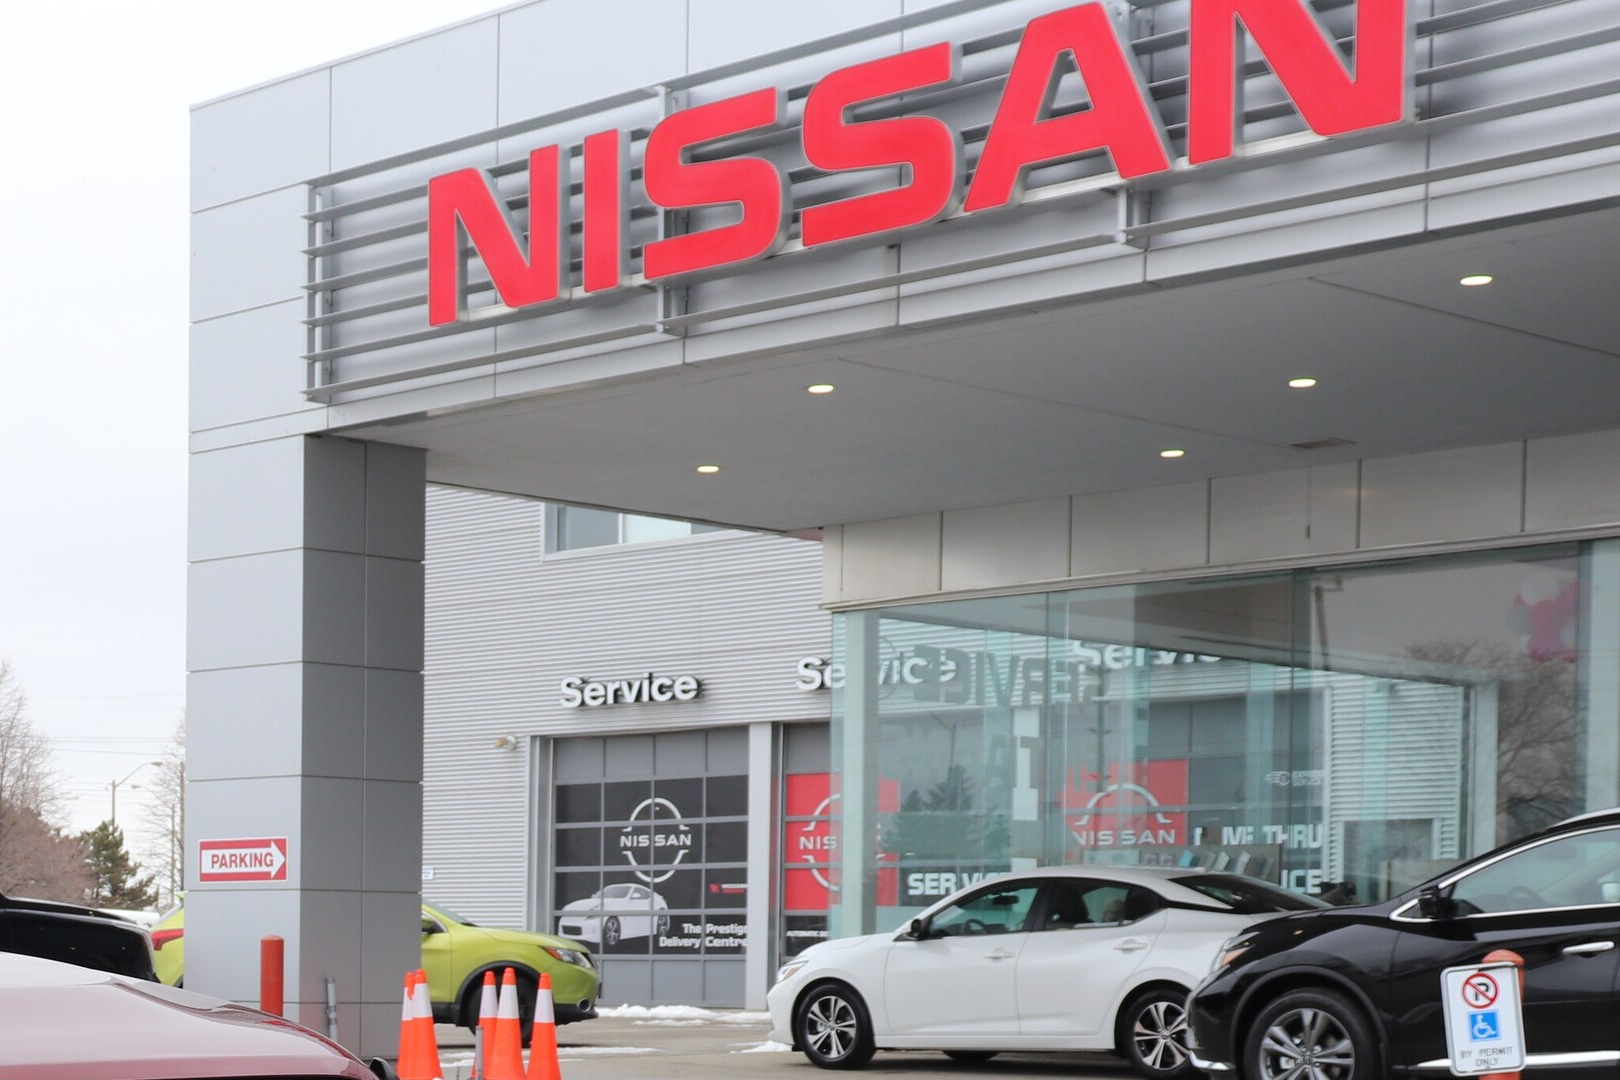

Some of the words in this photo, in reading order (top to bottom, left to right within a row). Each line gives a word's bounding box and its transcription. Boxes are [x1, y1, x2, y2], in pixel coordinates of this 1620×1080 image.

[429, 0, 1405, 327] NISSAN
[560, 672, 698, 708] Service
[620, 834, 692, 848] NISSAN
[1263, 824, 1323, 848] THRU
[211, 852, 274, 869] PARKING
[682, 923, 702, 934] The
[659, 936, 701, 949] Delivery
[1461, 1050, 1472, 1058] BY
[1480, 1046, 1513, 1056] PERMIT
[1476, 1057, 1499, 1066] ONLY
